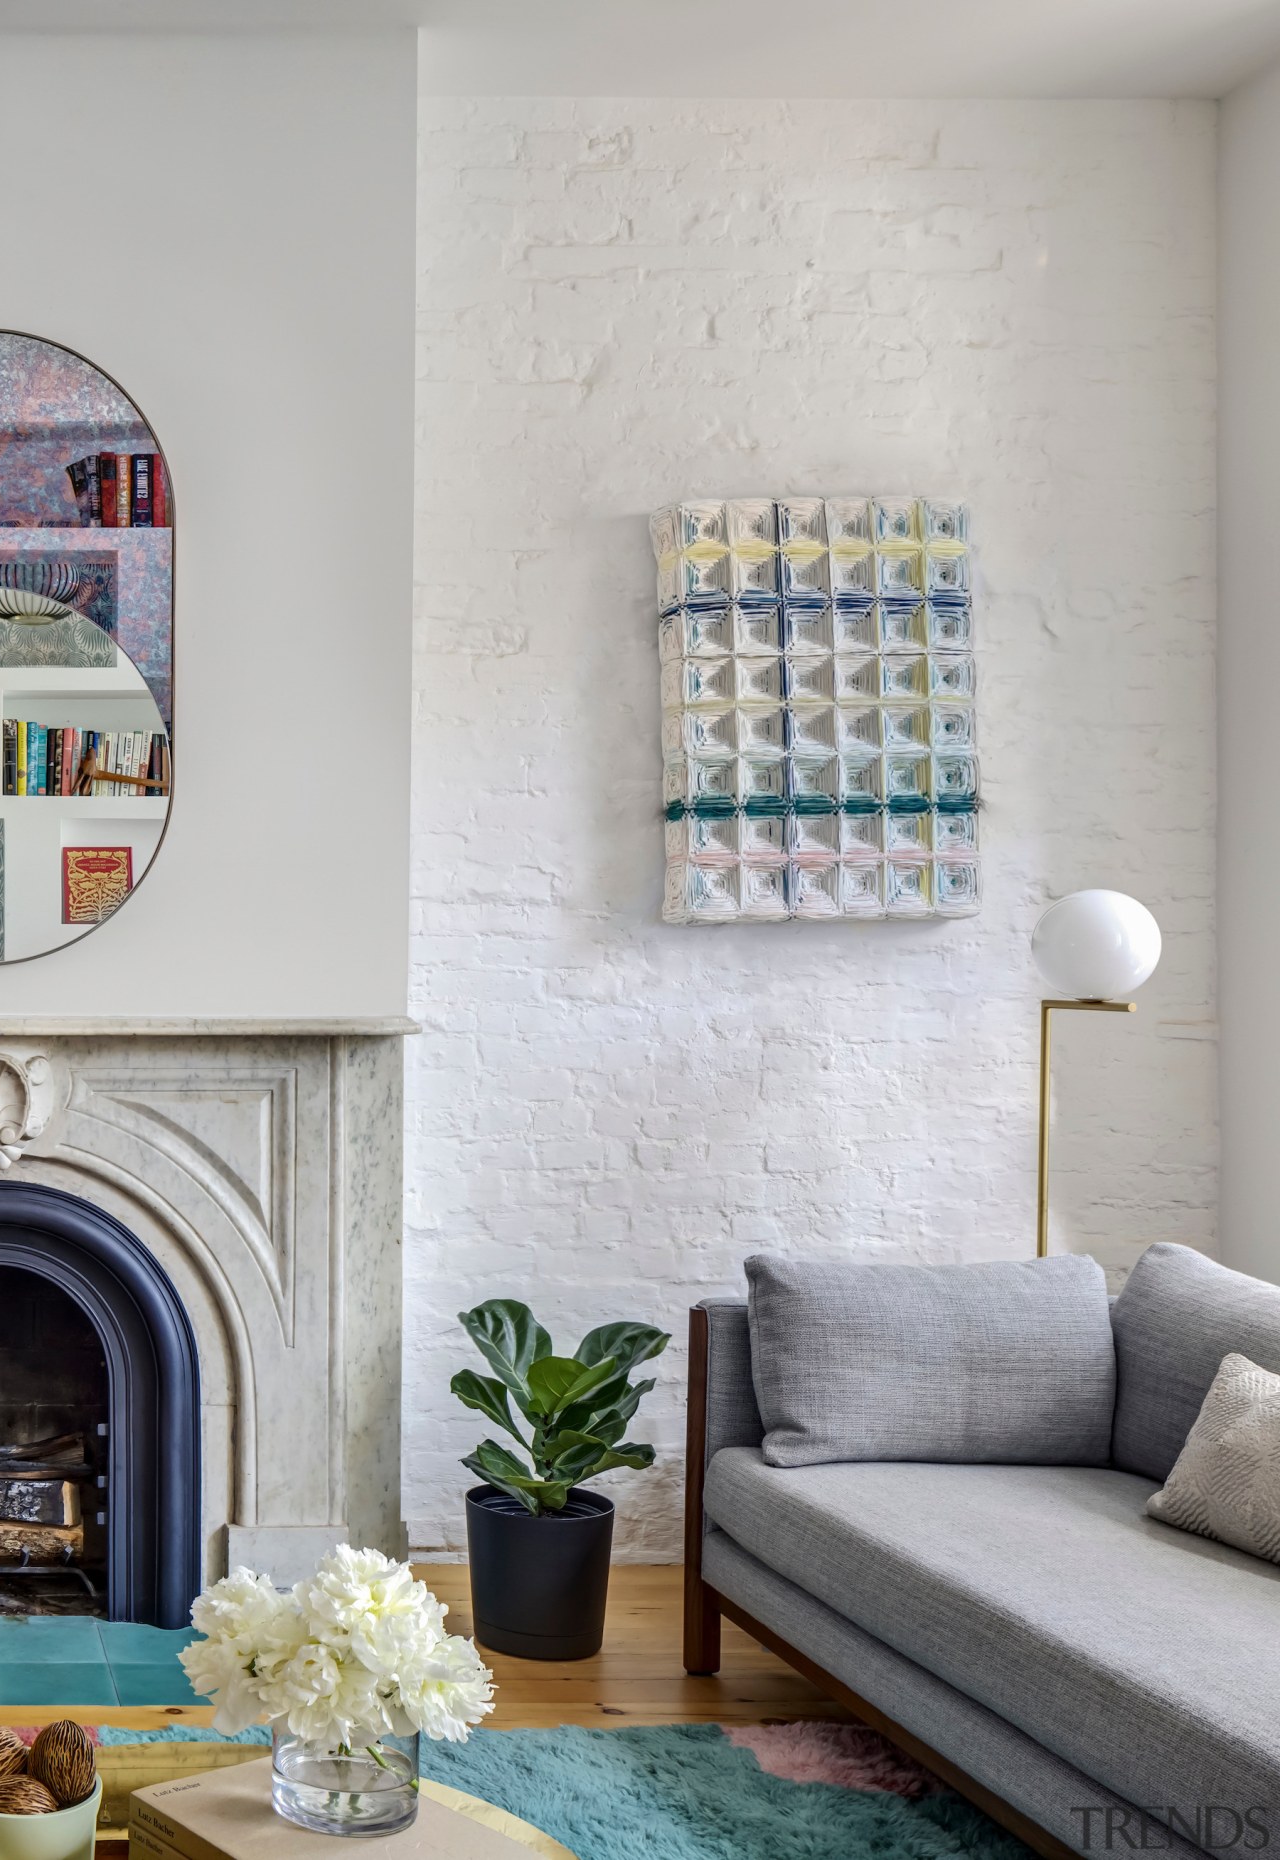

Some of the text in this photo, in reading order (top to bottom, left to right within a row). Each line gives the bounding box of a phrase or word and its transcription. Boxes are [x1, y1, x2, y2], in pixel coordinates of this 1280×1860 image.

[172, 1783, 200, 1792] Bacher
[138, 1808, 174, 1838] Lutz Bacher
